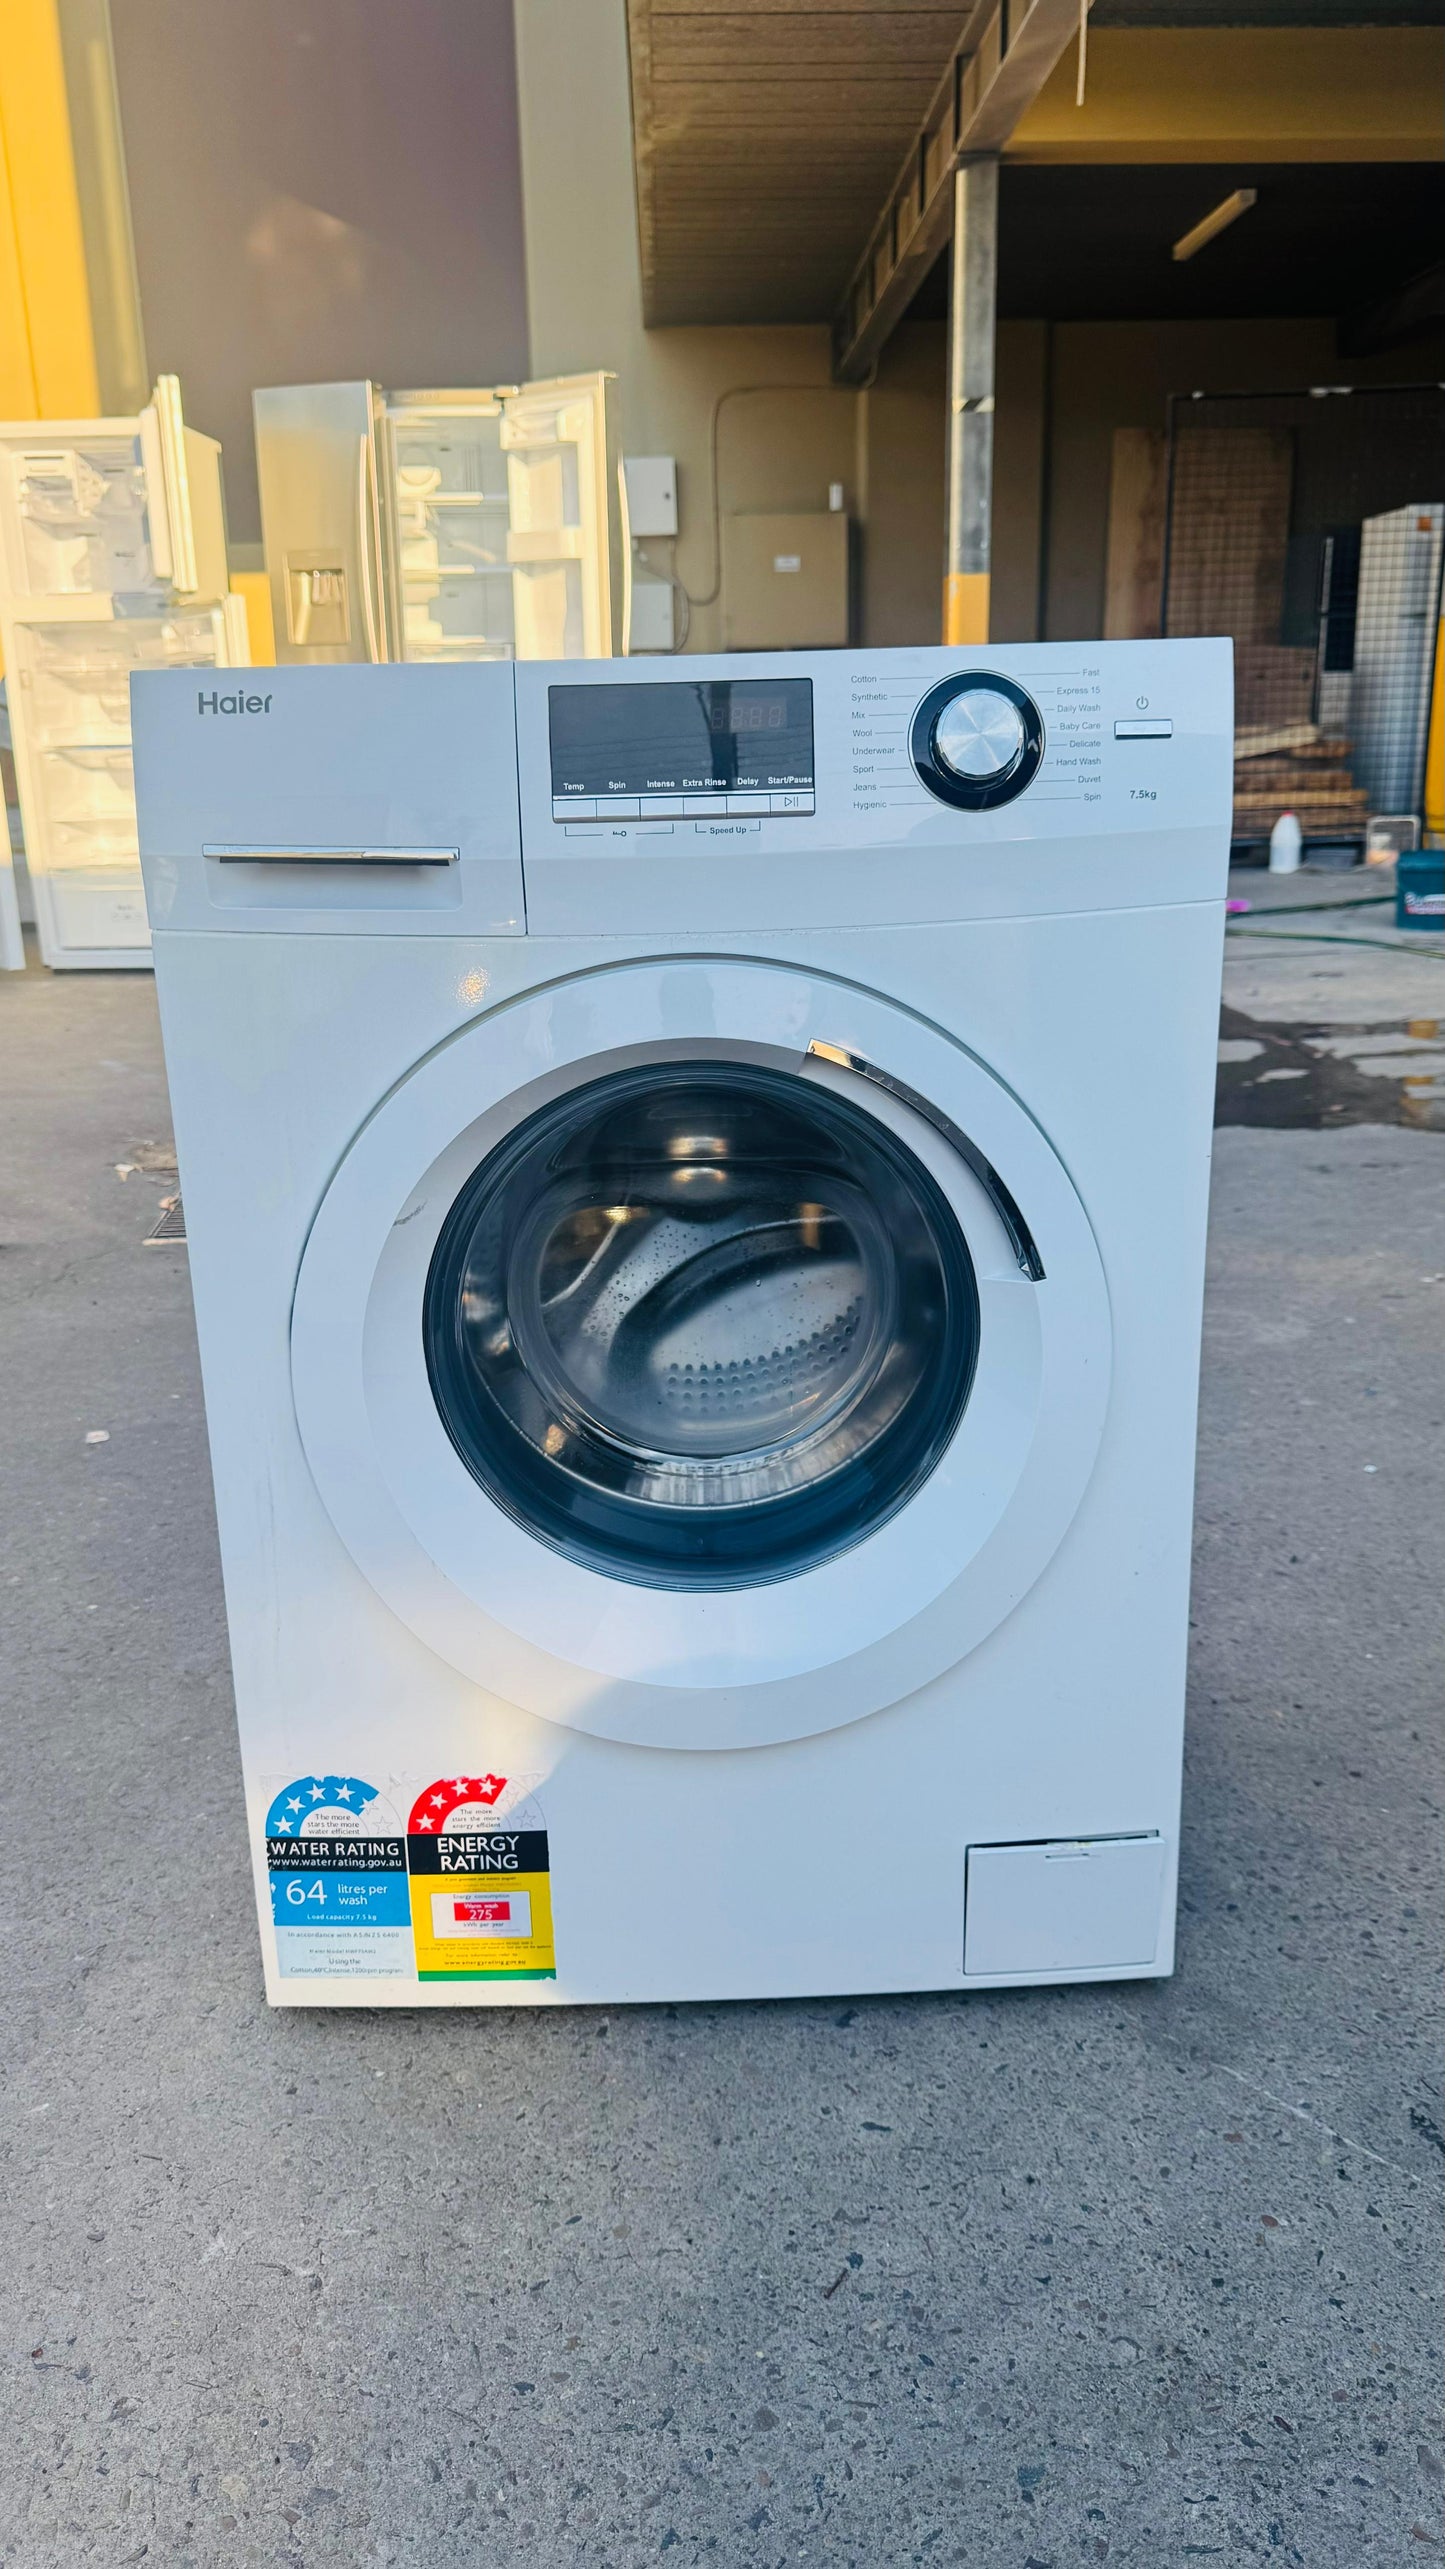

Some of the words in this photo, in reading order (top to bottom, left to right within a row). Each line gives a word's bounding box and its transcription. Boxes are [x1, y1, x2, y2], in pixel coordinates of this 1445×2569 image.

[1082, 668, 1100, 676] Fast
[850, 675, 877, 684] Cotton
[1056, 687, 1088, 696] Express
[1091, 686, 1100, 694] 15
[198, 690, 272, 714] Haier
[851, 693, 888, 703] Synthetic
[1057, 704, 1077, 714] Daily
[1059, 722, 1080, 731] Baby
[1082, 722, 1101, 730] Care
[852, 729, 872, 737] Wool
[1069, 740, 1101, 748] Delicate
[852, 747, 895, 755] Underwear
[1056, 758, 1077, 766] Hand
[1079, 757, 1102, 765] Wash
[853, 765, 874, 774] Sport
[647, 780, 675, 788] Intense
[682, 779, 703, 787] Extra
[704, 778, 727, 787] Rinse
[737, 777, 760, 787] Delay
[767, 776, 813, 785] Start/Pause
[1078, 775, 1101, 784] Duvet
[563, 782, 585, 792] Temp
[608, 781, 626, 791] Spin
[853, 784, 877, 792] Jeans
[1084, 793, 1102, 802] Spin
[1130, 790, 1157, 800] 7.5kg
[853, 800, 887, 810] Hygienic
[710, 827, 734, 836] Speed
[736, 826, 747, 835] Up
[270, 1842, 330, 1856] WATER
[335, 1842, 400, 1856] RATING
[437, 1835, 520, 1853] ENERGY
[272, 1858, 402, 1869] www.waterrating.gov.au
[440, 1854, 519, 1871] RATING
[286, 1879, 328, 1905] 64
[337, 1883, 366, 1894] litres
[368, 1885, 388, 1896] per
[338, 1895, 368, 1905] wash
[469, 1909, 493, 1920] 275
